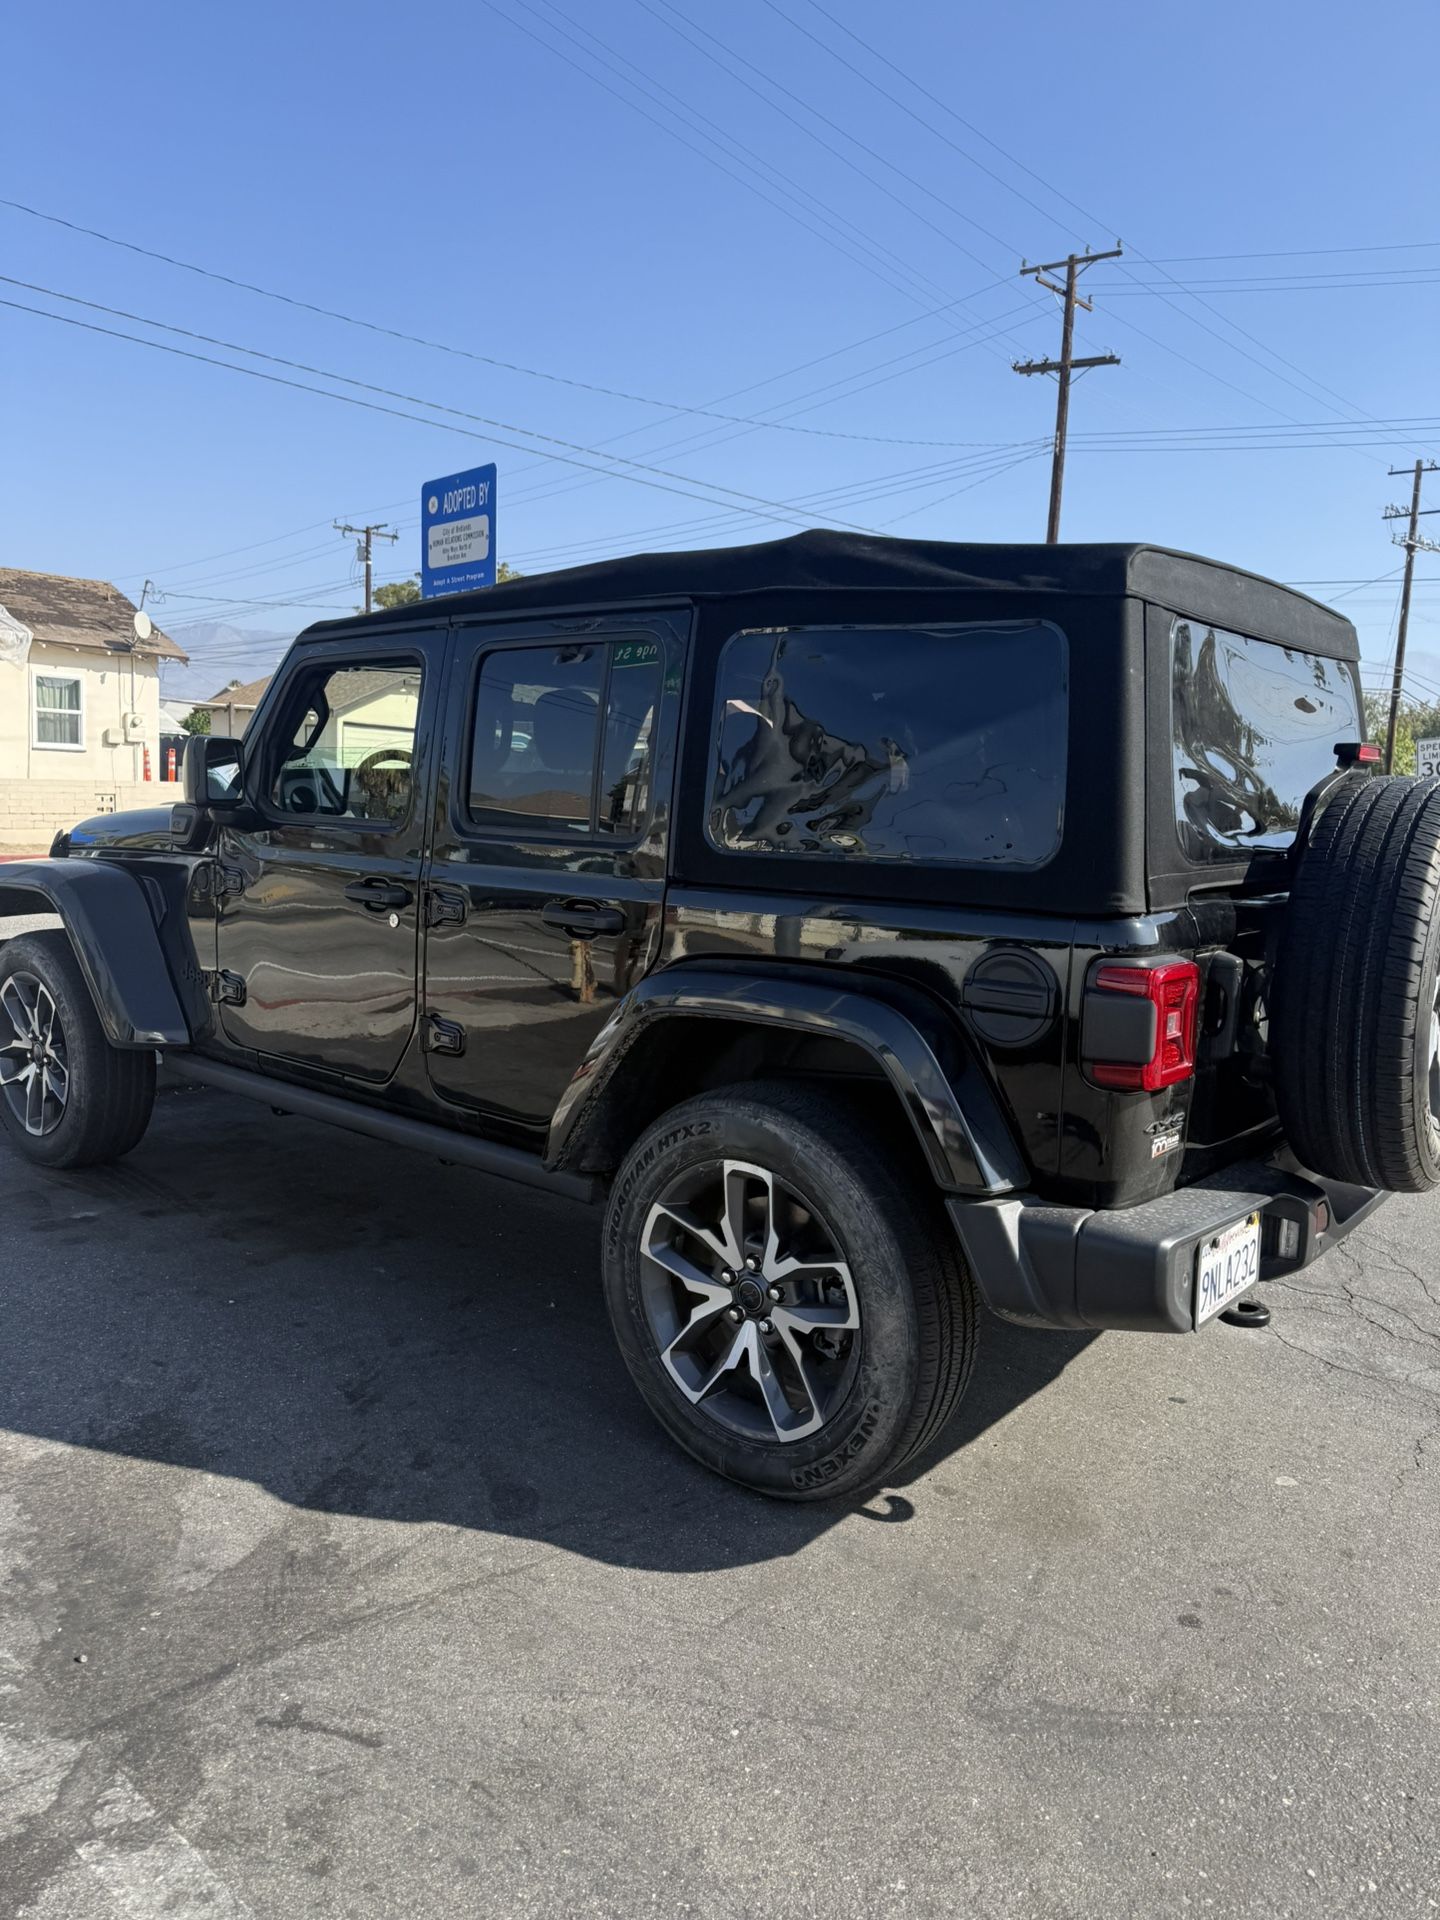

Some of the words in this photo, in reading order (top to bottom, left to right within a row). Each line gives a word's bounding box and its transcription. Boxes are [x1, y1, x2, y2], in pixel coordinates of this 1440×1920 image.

[443, 486, 476, 515] ADOPTED
[479, 481, 490, 506] BY
[433, 578, 445, 586] Adopt
[451, 575, 465, 584] Street
[466, 573, 485, 581] Program
[1201, 1238, 1257, 1313] 9NLA232
[803, 1412, 879, 1483] NEXEN
